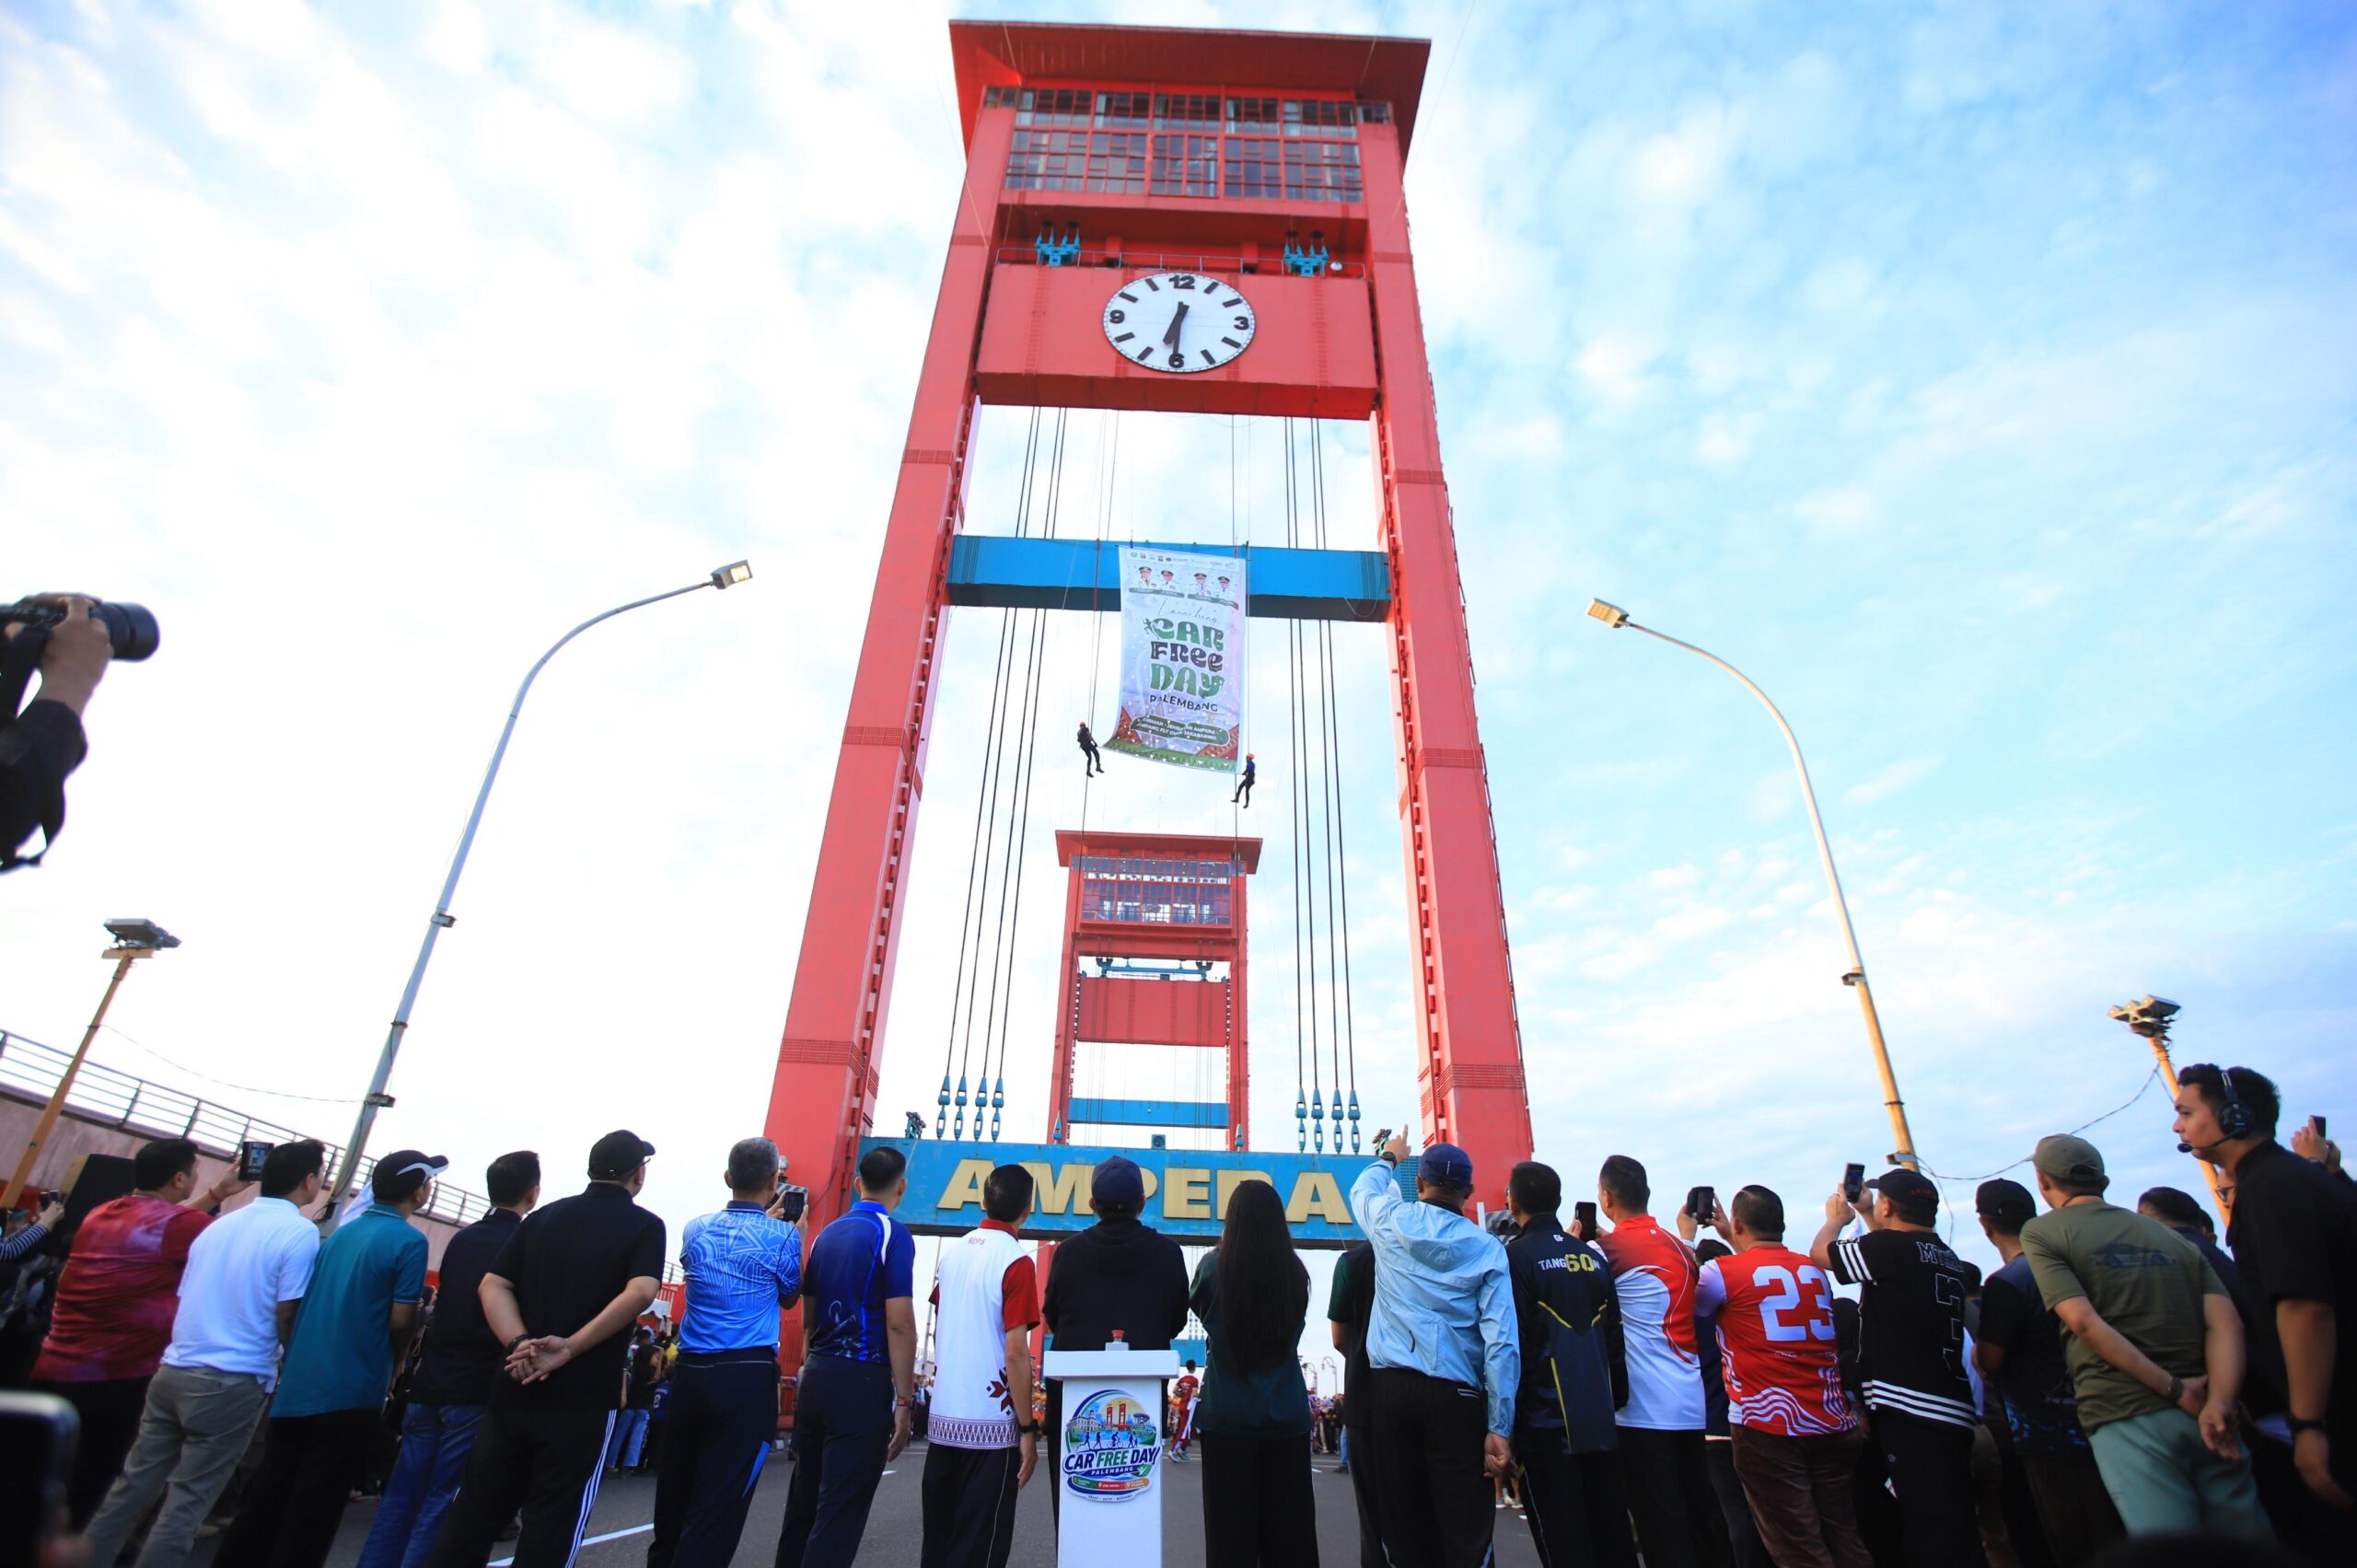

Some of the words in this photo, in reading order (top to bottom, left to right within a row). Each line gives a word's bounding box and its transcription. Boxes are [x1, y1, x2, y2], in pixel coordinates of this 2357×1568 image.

[1168, 274, 1195, 290] 12
[1109, 309, 1125, 324] 9
[1234, 316, 1249, 331] 3
[1168, 353, 1185, 368] 6
[1152, 618, 1225, 652] CAR
[1150, 663, 1225, 699] DAY
[1150, 693, 1218, 712] PALEMBANG
[1752, 1264, 1836, 1342] 23
[1064, 1453, 1095, 1470] CAR
[1096, 1449, 1129, 1468] FREE
[1091, 1466, 1133, 1476] PALEMBANG
